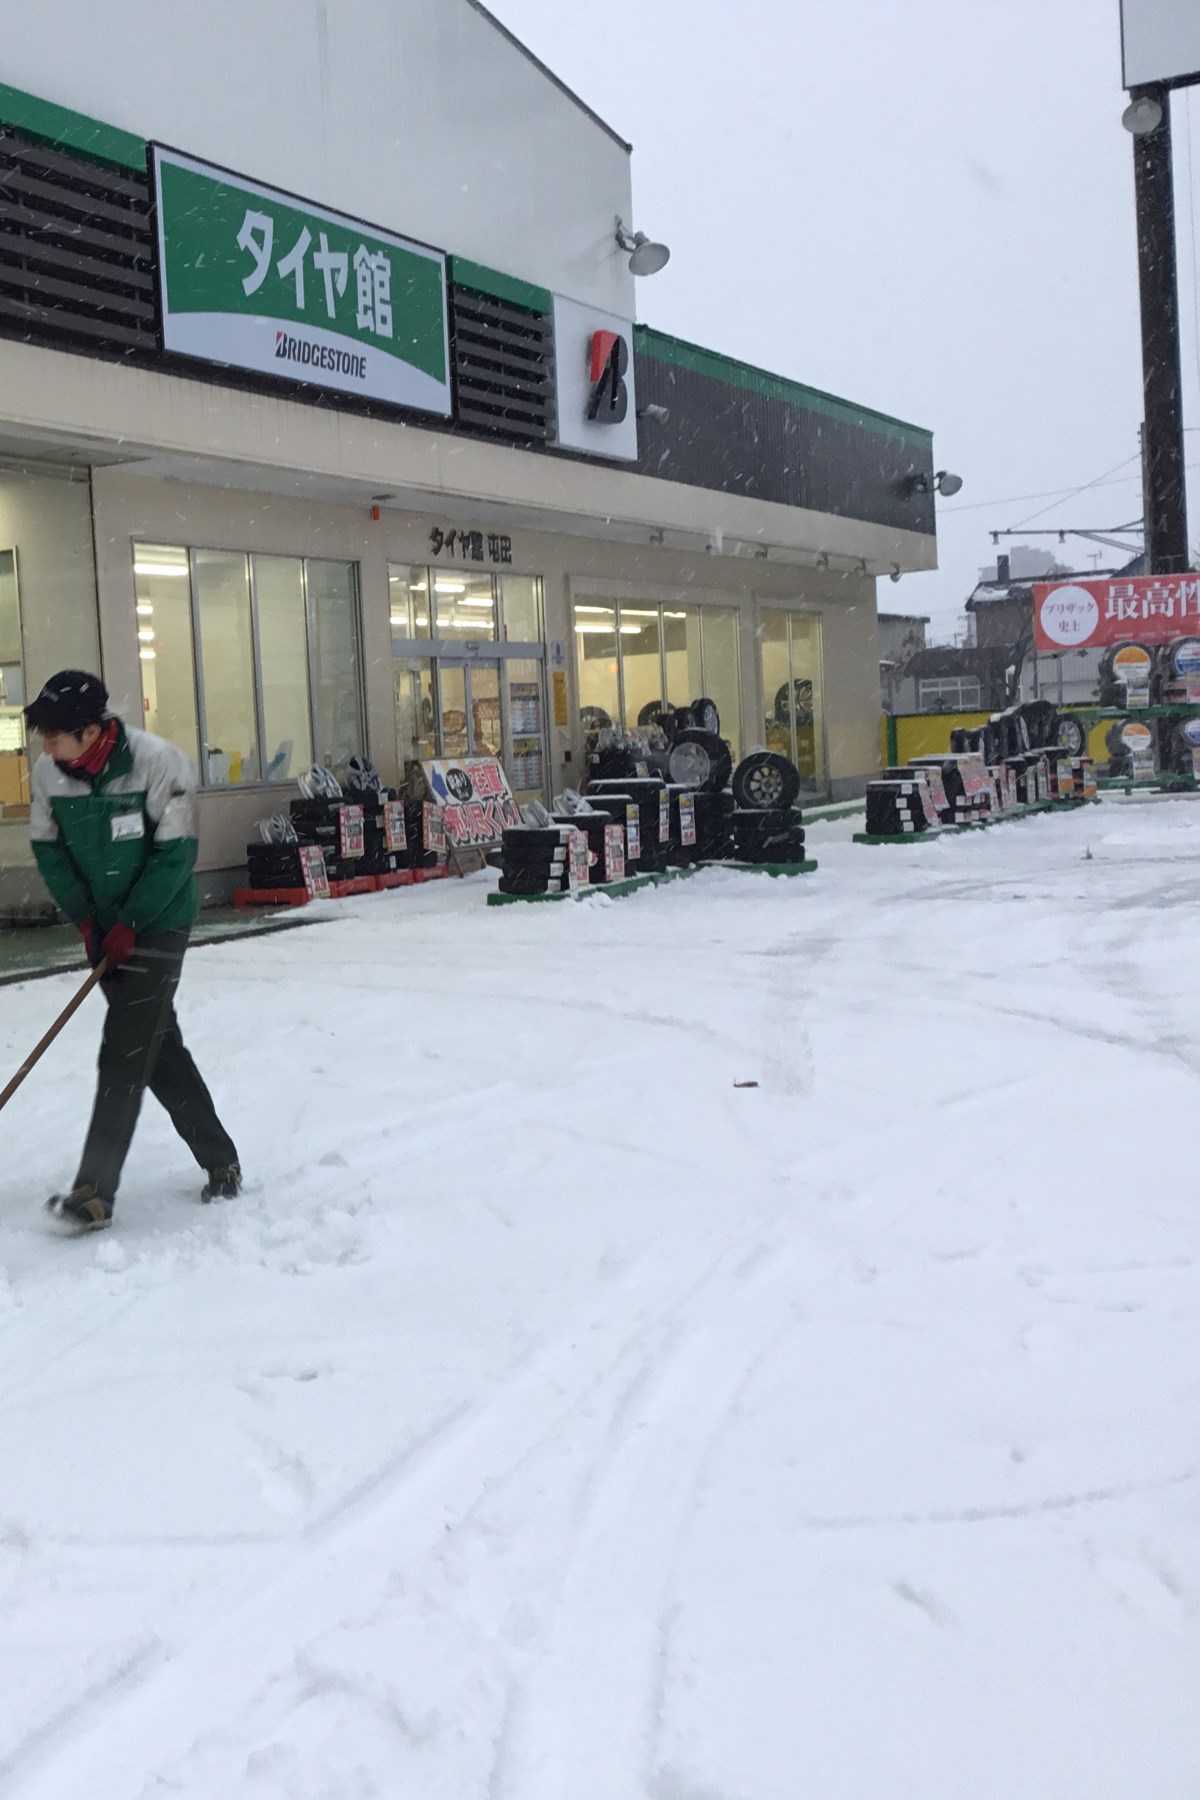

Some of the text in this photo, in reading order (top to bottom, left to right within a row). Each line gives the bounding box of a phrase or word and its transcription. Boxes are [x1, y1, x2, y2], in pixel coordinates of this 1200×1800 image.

[236, 209, 394, 339] タイヤ館
[276, 331, 367, 379] BRIDGESTONE
[429, 527, 485, 562] タイヤ館
[1104, 579, 1200, 621] 最高性
